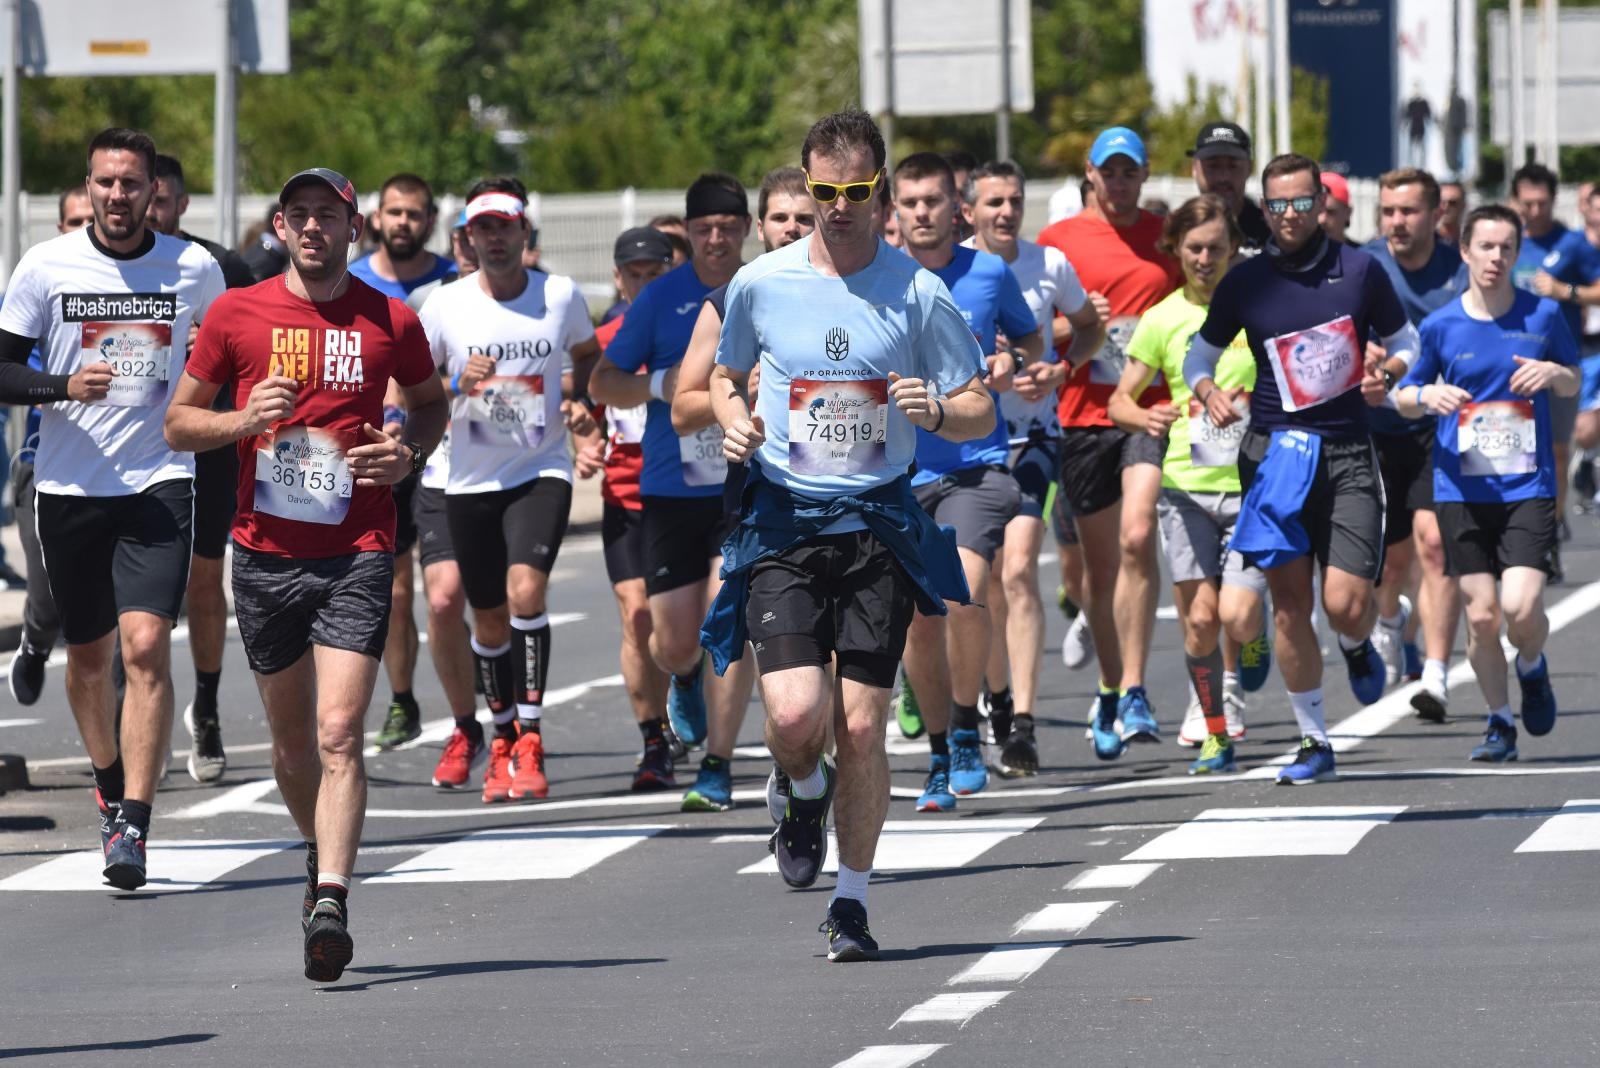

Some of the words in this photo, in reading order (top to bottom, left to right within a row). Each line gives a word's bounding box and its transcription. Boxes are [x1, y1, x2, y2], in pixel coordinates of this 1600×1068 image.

[66, 297, 172, 319] #bašmebriga
[325, 329, 361, 356] RIJ
[467, 339, 552, 361] DOBRO
[99, 360, 156, 377] 1922
[324, 355, 363, 383] EKA
[818, 369, 873, 377] ORAHOVICA
[324, 382, 363, 392] TRAIL
[806, 422, 873, 443] 74919
[876, 430, 885, 443] 2
[831, 450, 850, 459] Ivan
[272, 465, 336, 491] 36153
[342, 484, 350, 496] 2
[287, 494, 313, 505] Davor
